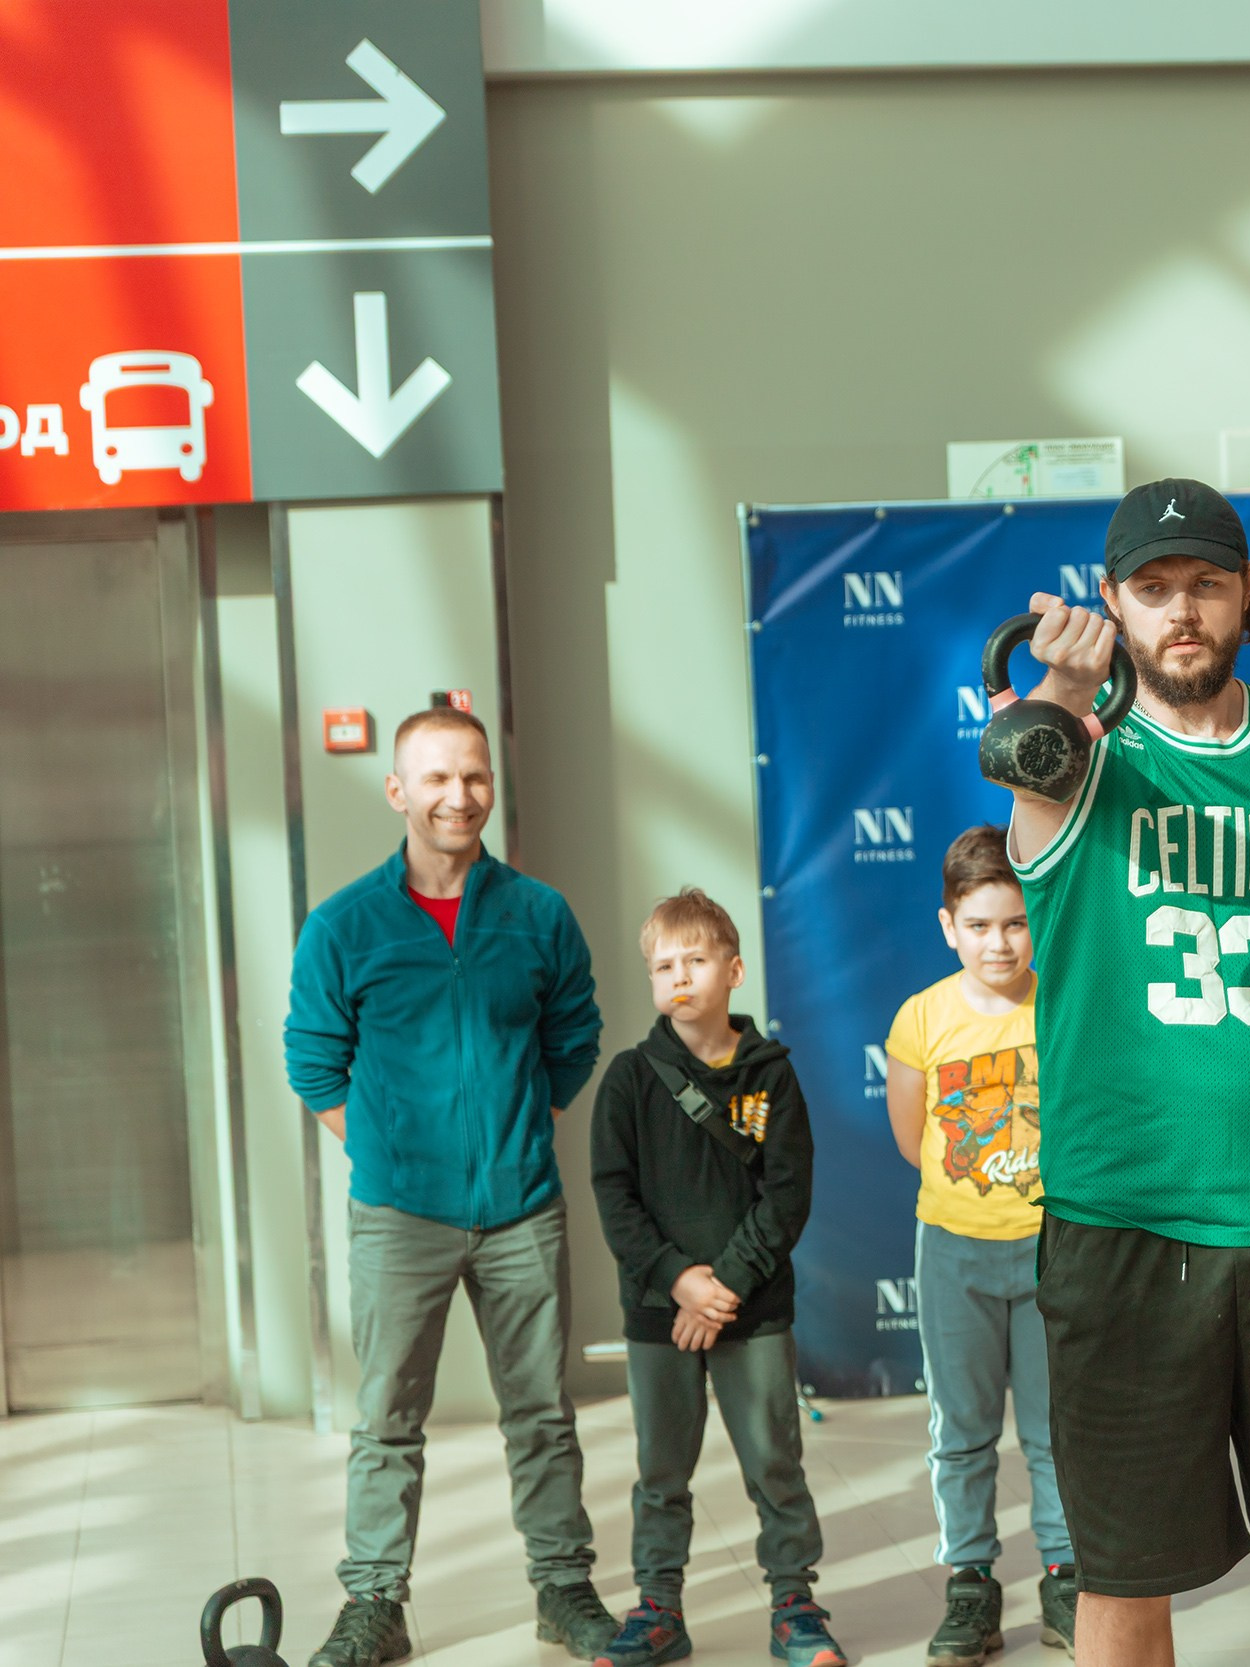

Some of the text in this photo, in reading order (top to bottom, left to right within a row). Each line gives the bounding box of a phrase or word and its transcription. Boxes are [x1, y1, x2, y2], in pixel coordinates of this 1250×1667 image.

[844, 571, 903, 608] NN
[845, 614, 904, 626] FITNESS
[1119, 737, 1145, 751] adidas
[853, 806, 914, 844] NN
[854, 849, 916, 862] FITNESS
